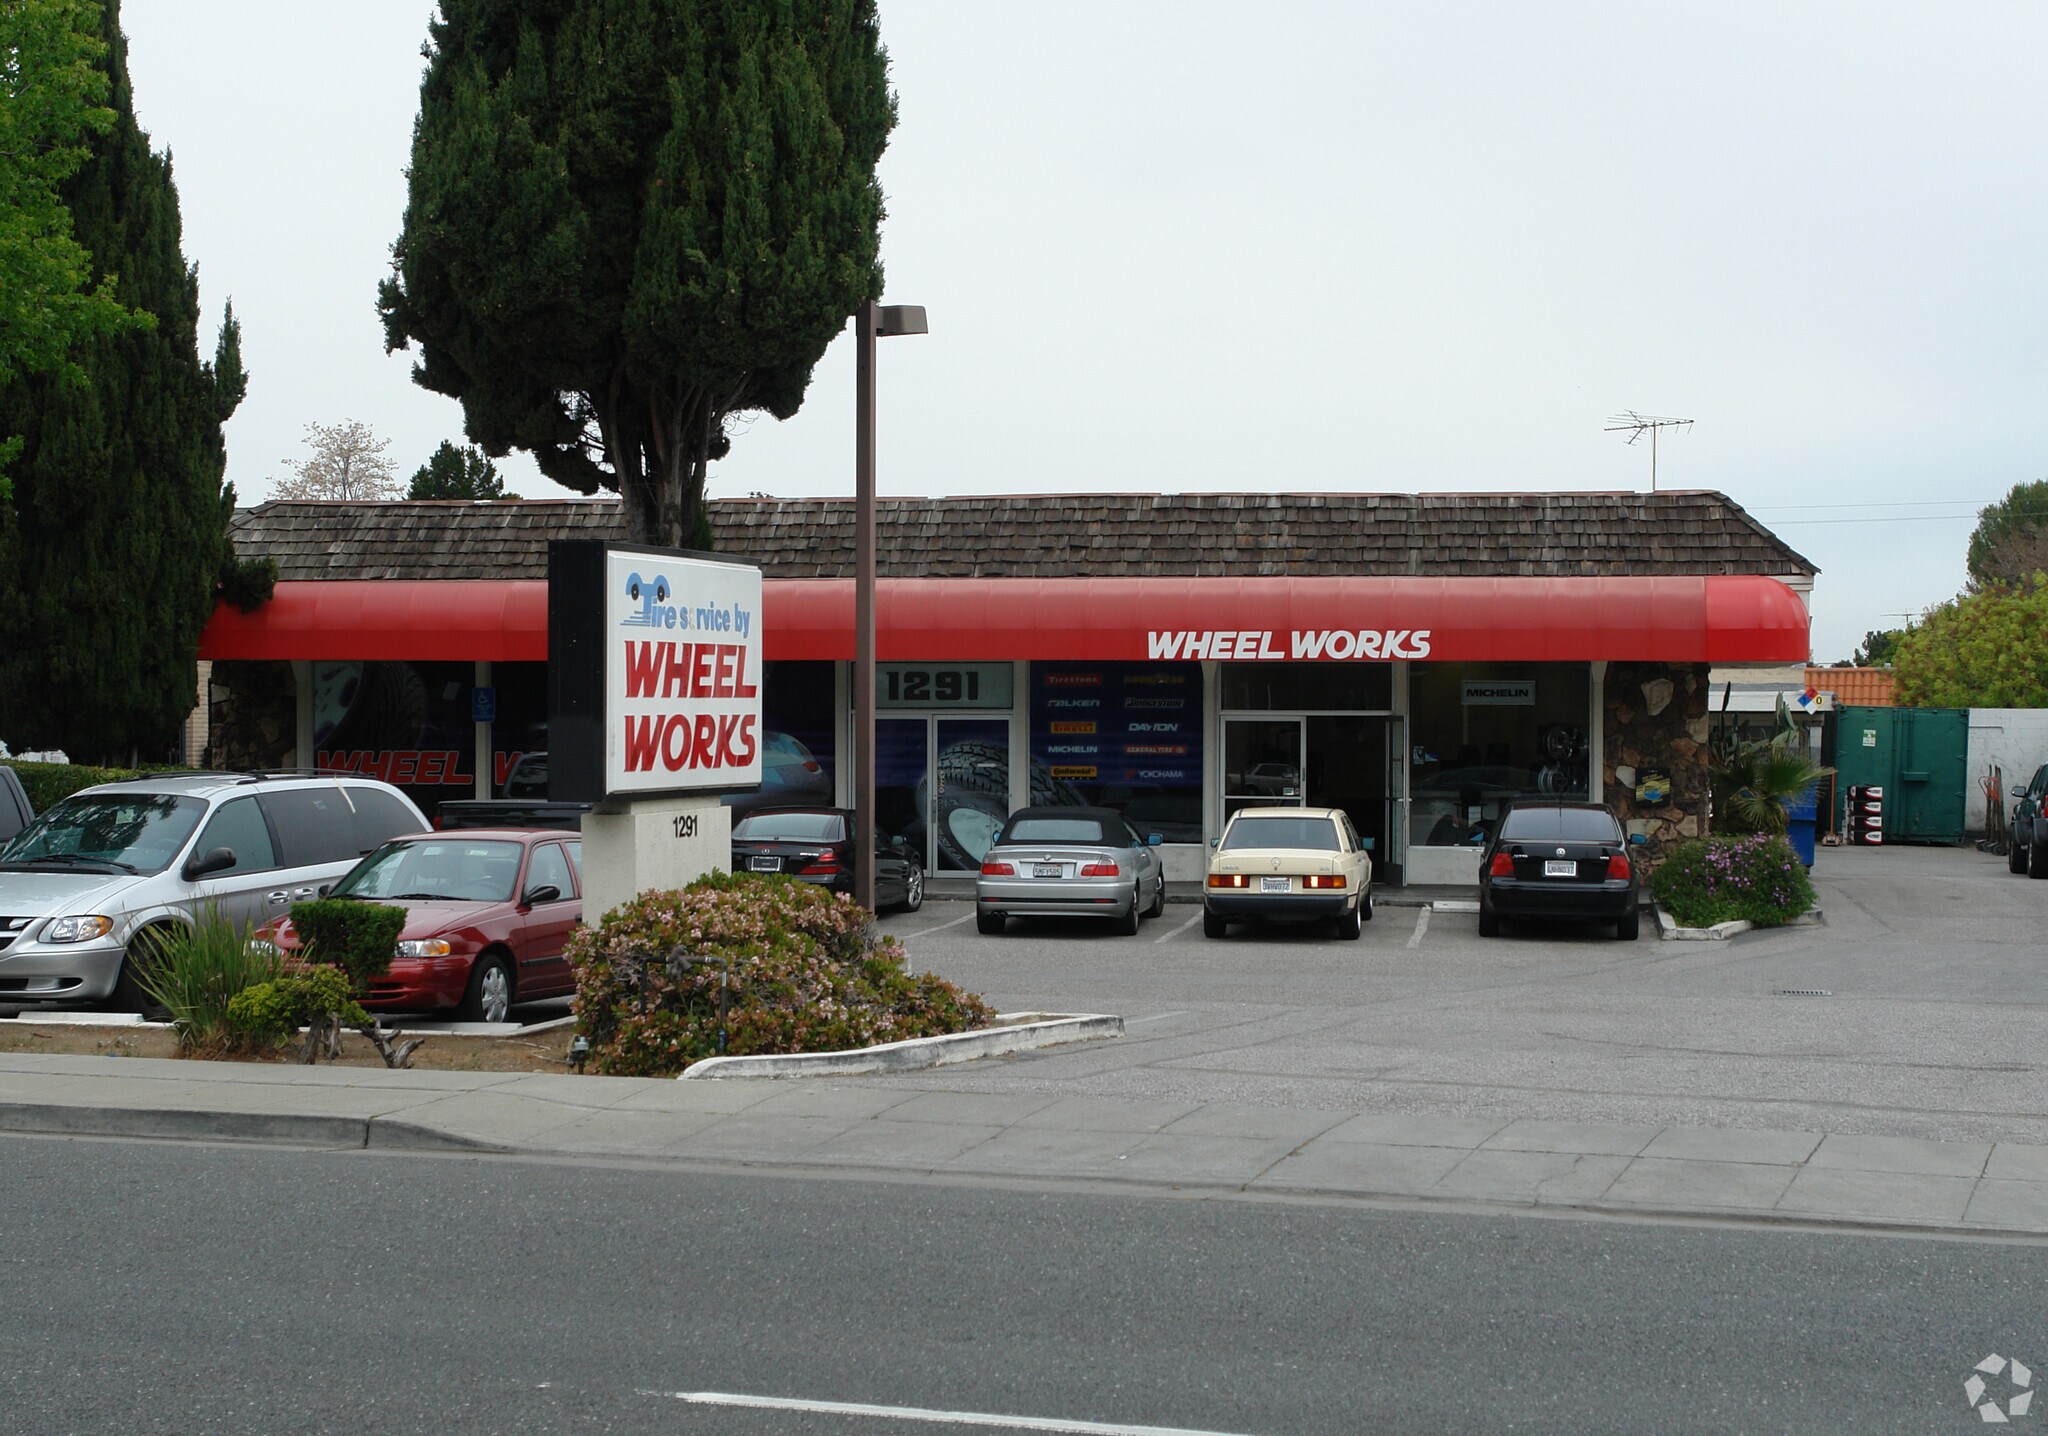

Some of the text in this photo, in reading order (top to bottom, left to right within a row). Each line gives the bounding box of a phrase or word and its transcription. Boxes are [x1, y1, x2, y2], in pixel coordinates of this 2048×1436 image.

[734, 601, 751, 639] by
[1148, 630, 1431, 659] WHEEL WORKS
[624, 640, 758, 699] WHEEL
[886, 671, 979, 701] 1291
[1466, 688, 1529, 698] MICHELIN
[1048, 699, 1100, 707] FALKEN
[1815, 696, 1823, 705] 0
[1128, 723, 1178, 732] DAYTON
[624, 714, 756, 772] WORKS
[318, 751, 473, 785] WHEEL
[1138, 770, 1184, 778] YOKOHAMA
[672, 815, 698, 838] 1291
